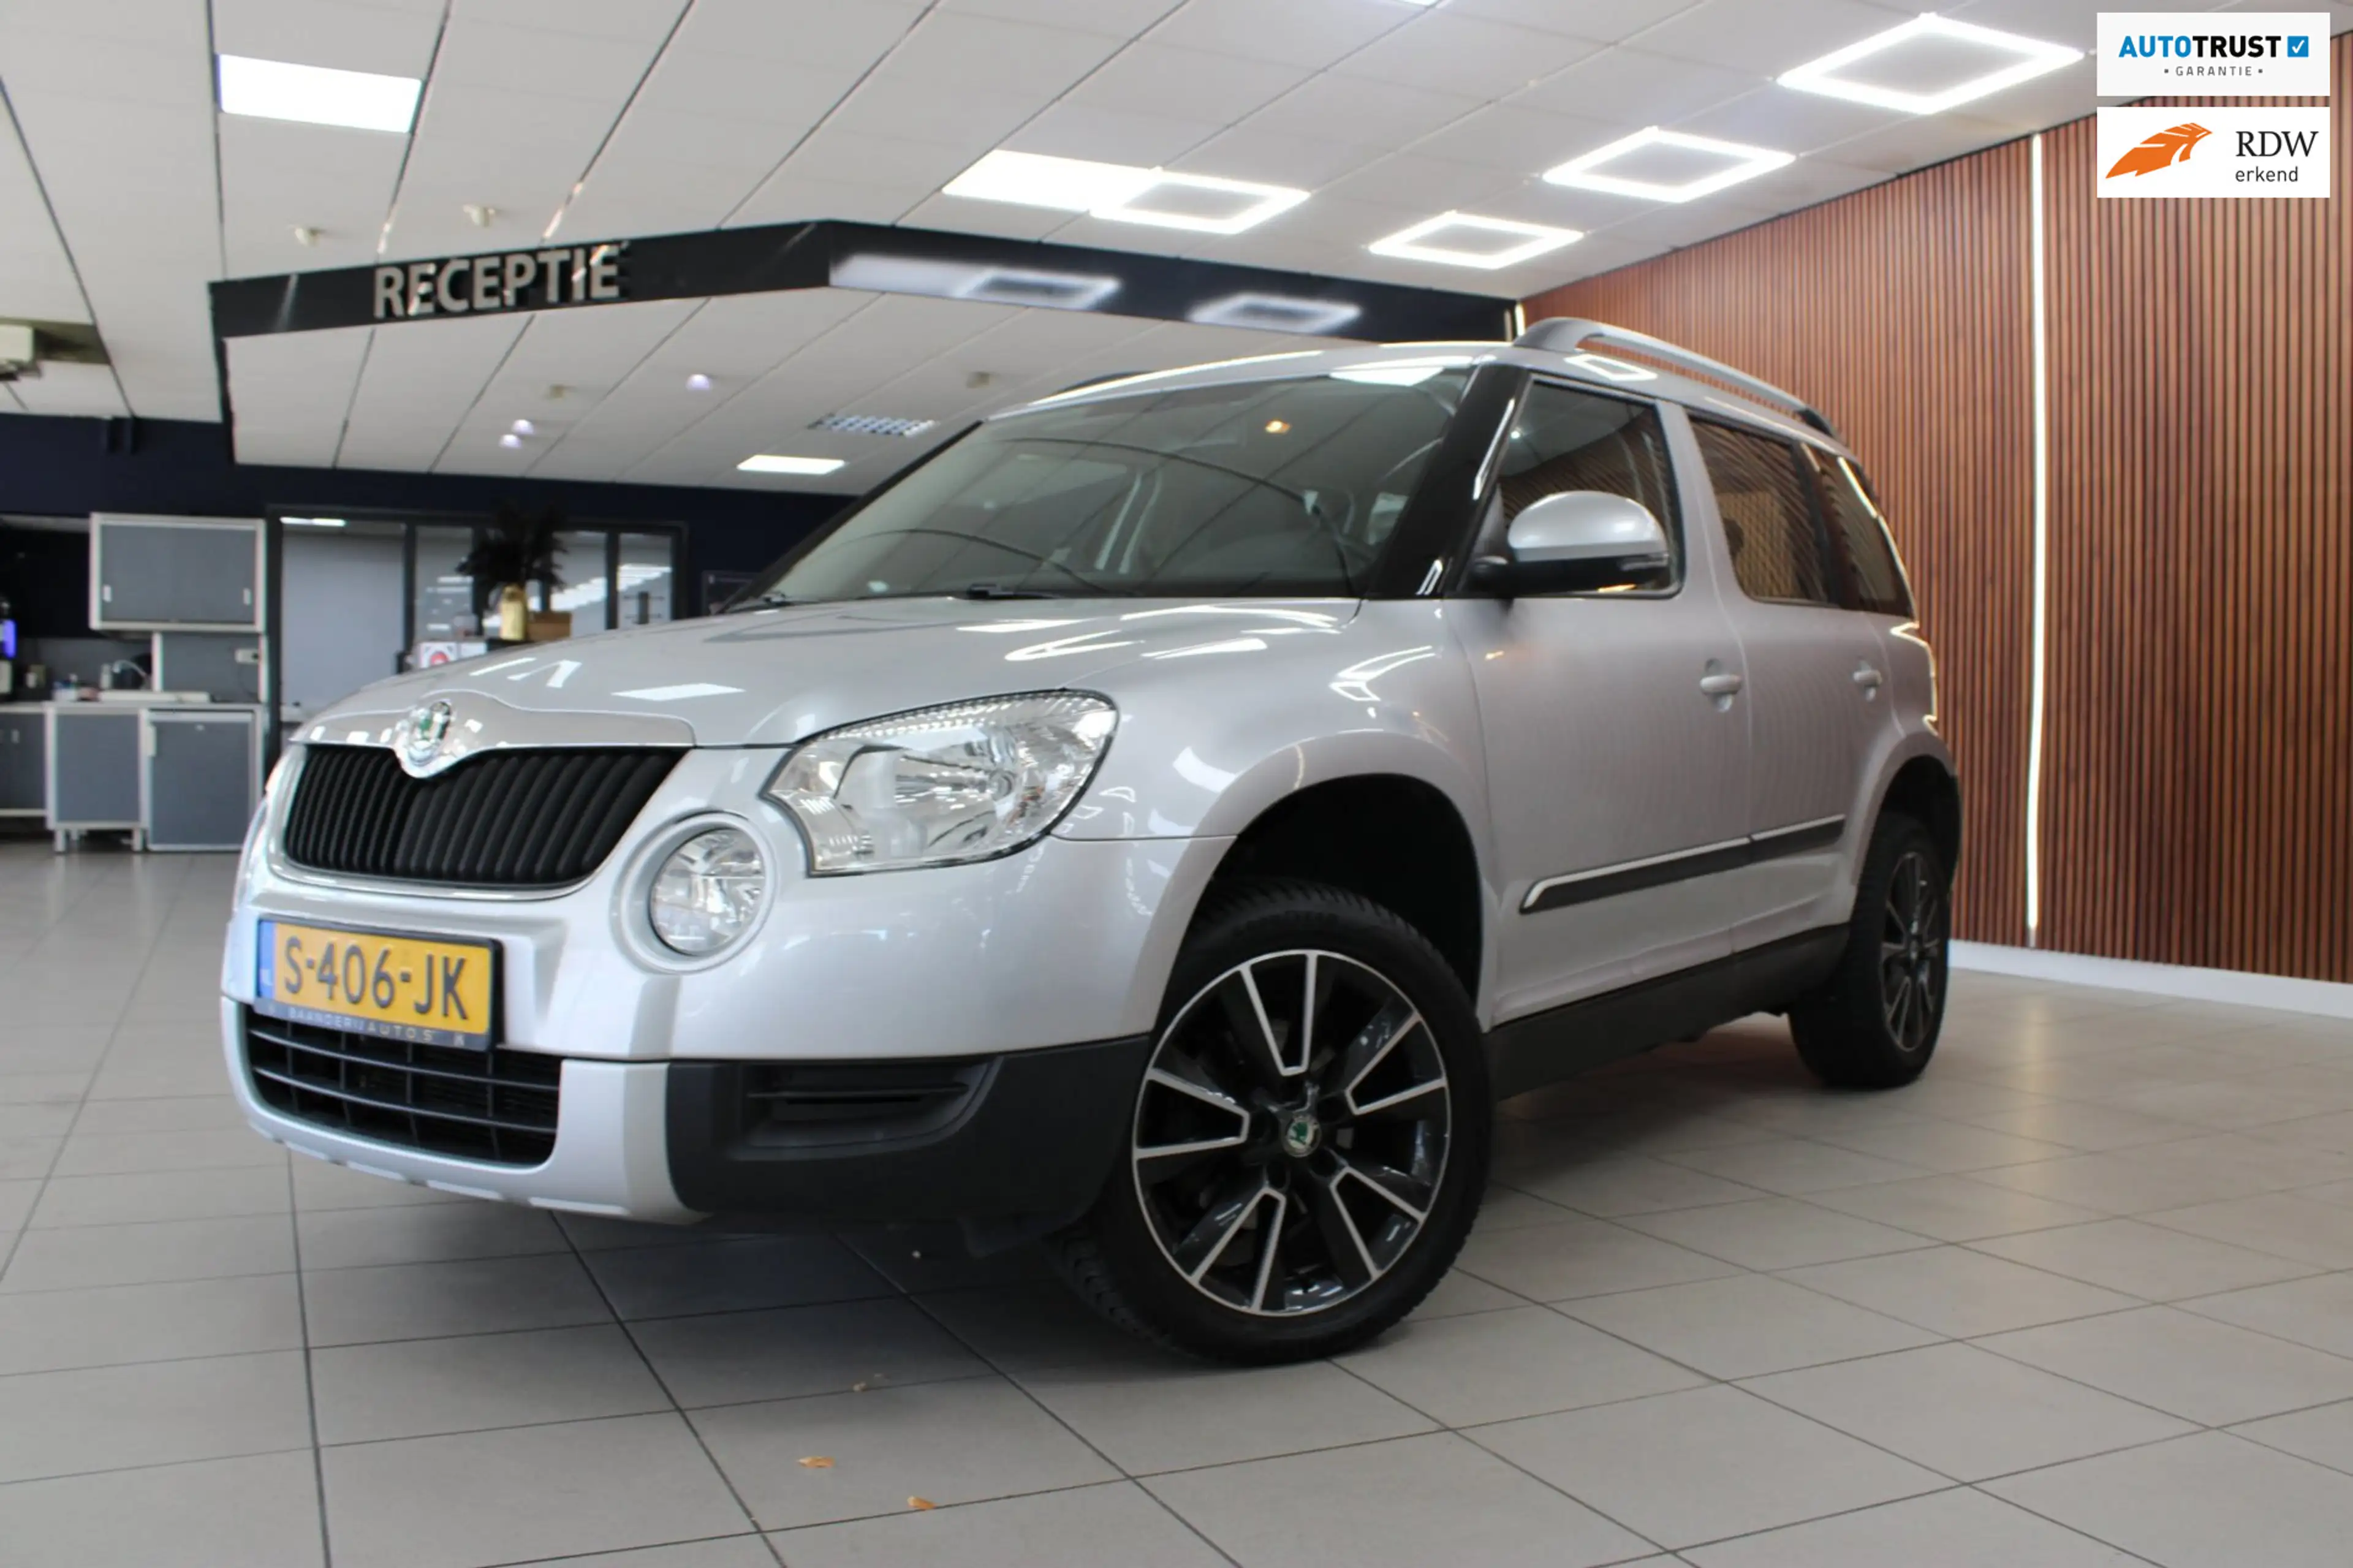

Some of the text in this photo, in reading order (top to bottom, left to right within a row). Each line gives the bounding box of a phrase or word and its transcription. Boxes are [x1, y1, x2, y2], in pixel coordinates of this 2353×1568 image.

[373, 244, 621, 319] RECEPTIE
[284, 936, 469, 1020] S-406-JK
[368, 1021, 433, 1042] AUTOS
